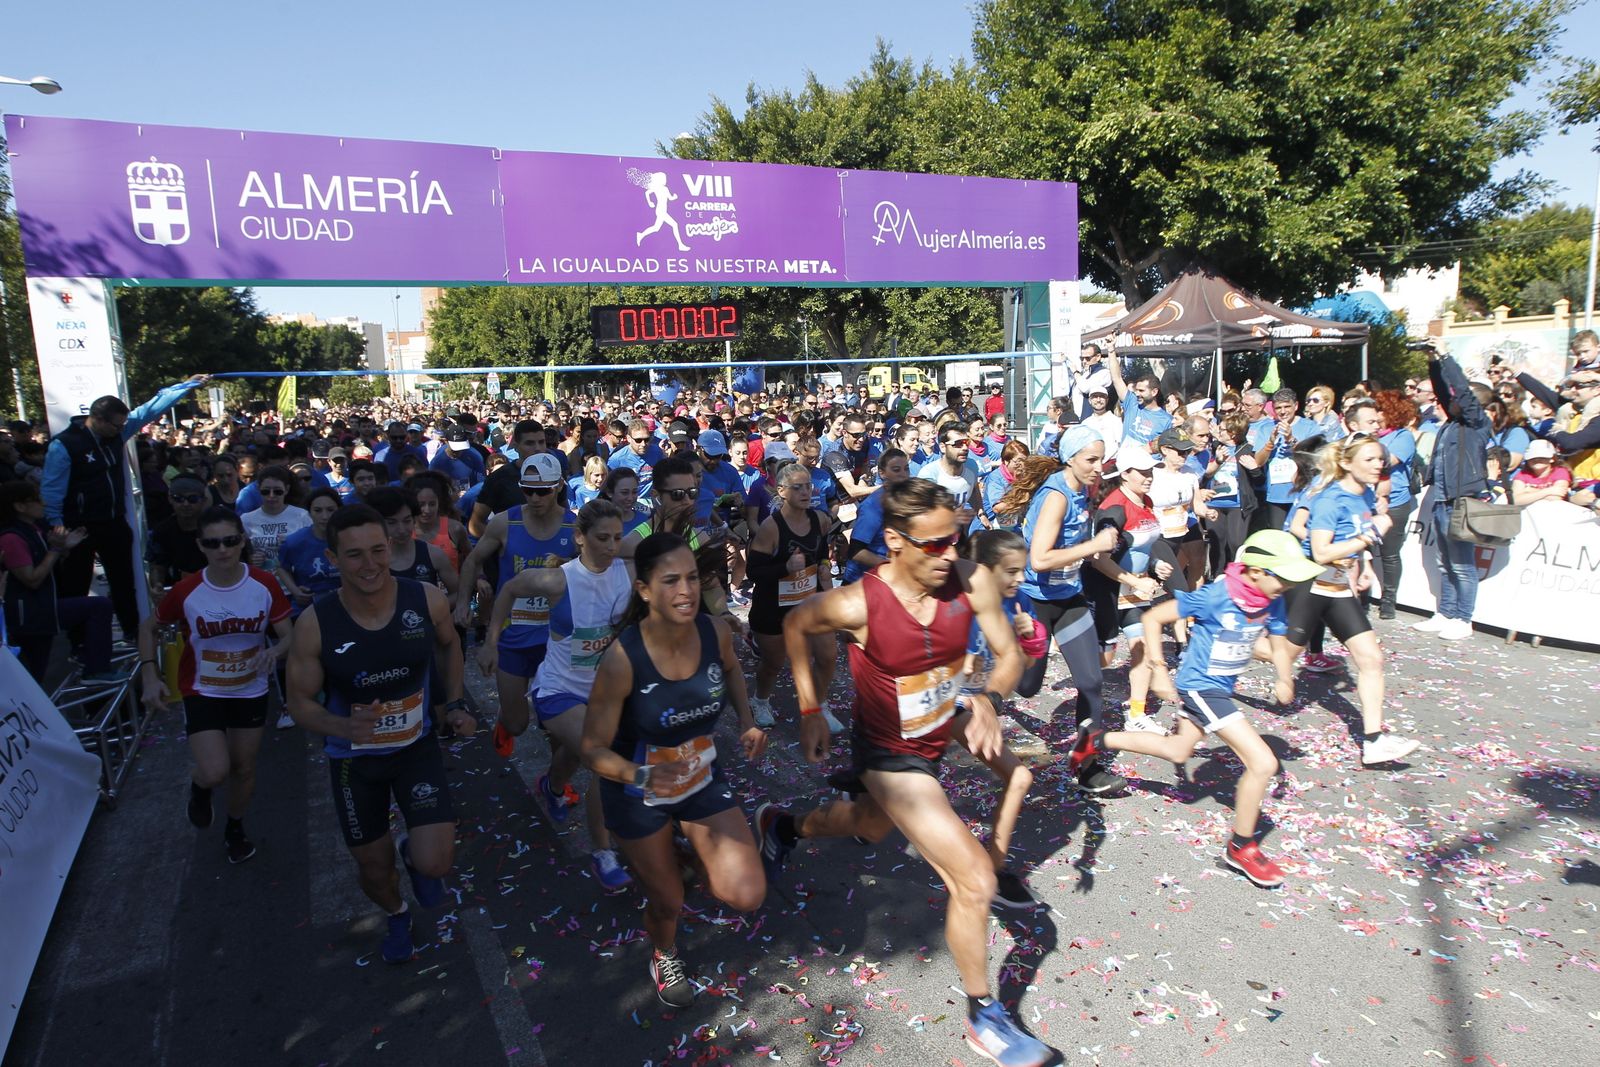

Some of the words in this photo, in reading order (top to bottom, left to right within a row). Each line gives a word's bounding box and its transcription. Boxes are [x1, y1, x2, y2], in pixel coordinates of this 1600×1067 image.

[238, 170, 453, 215] ALMERÍA
[682, 173, 733, 197] VIII
[685, 201, 736, 212] CARRERA
[685, 211, 704, 219] DE
[240, 215, 354, 242] CIUDAD
[686, 216, 739, 241] mujer
[519, 257, 546, 274] LA
[552, 257, 660, 274] IGUALDAD
[667, 258, 689, 274] ES
[695, 258, 779, 274] NUESTRA
[783, 259, 837, 275] META.
[56, 321, 86, 330] NEXA
[619, 305, 736, 341] 00:00:02
[261, 522, 288, 536] WE
[790, 579, 810, 590] 102
[216, 661, 247, 673] 442
[361, 666, 409, 686] DEHARO
[669, 702, 720, 725] DEHARO
